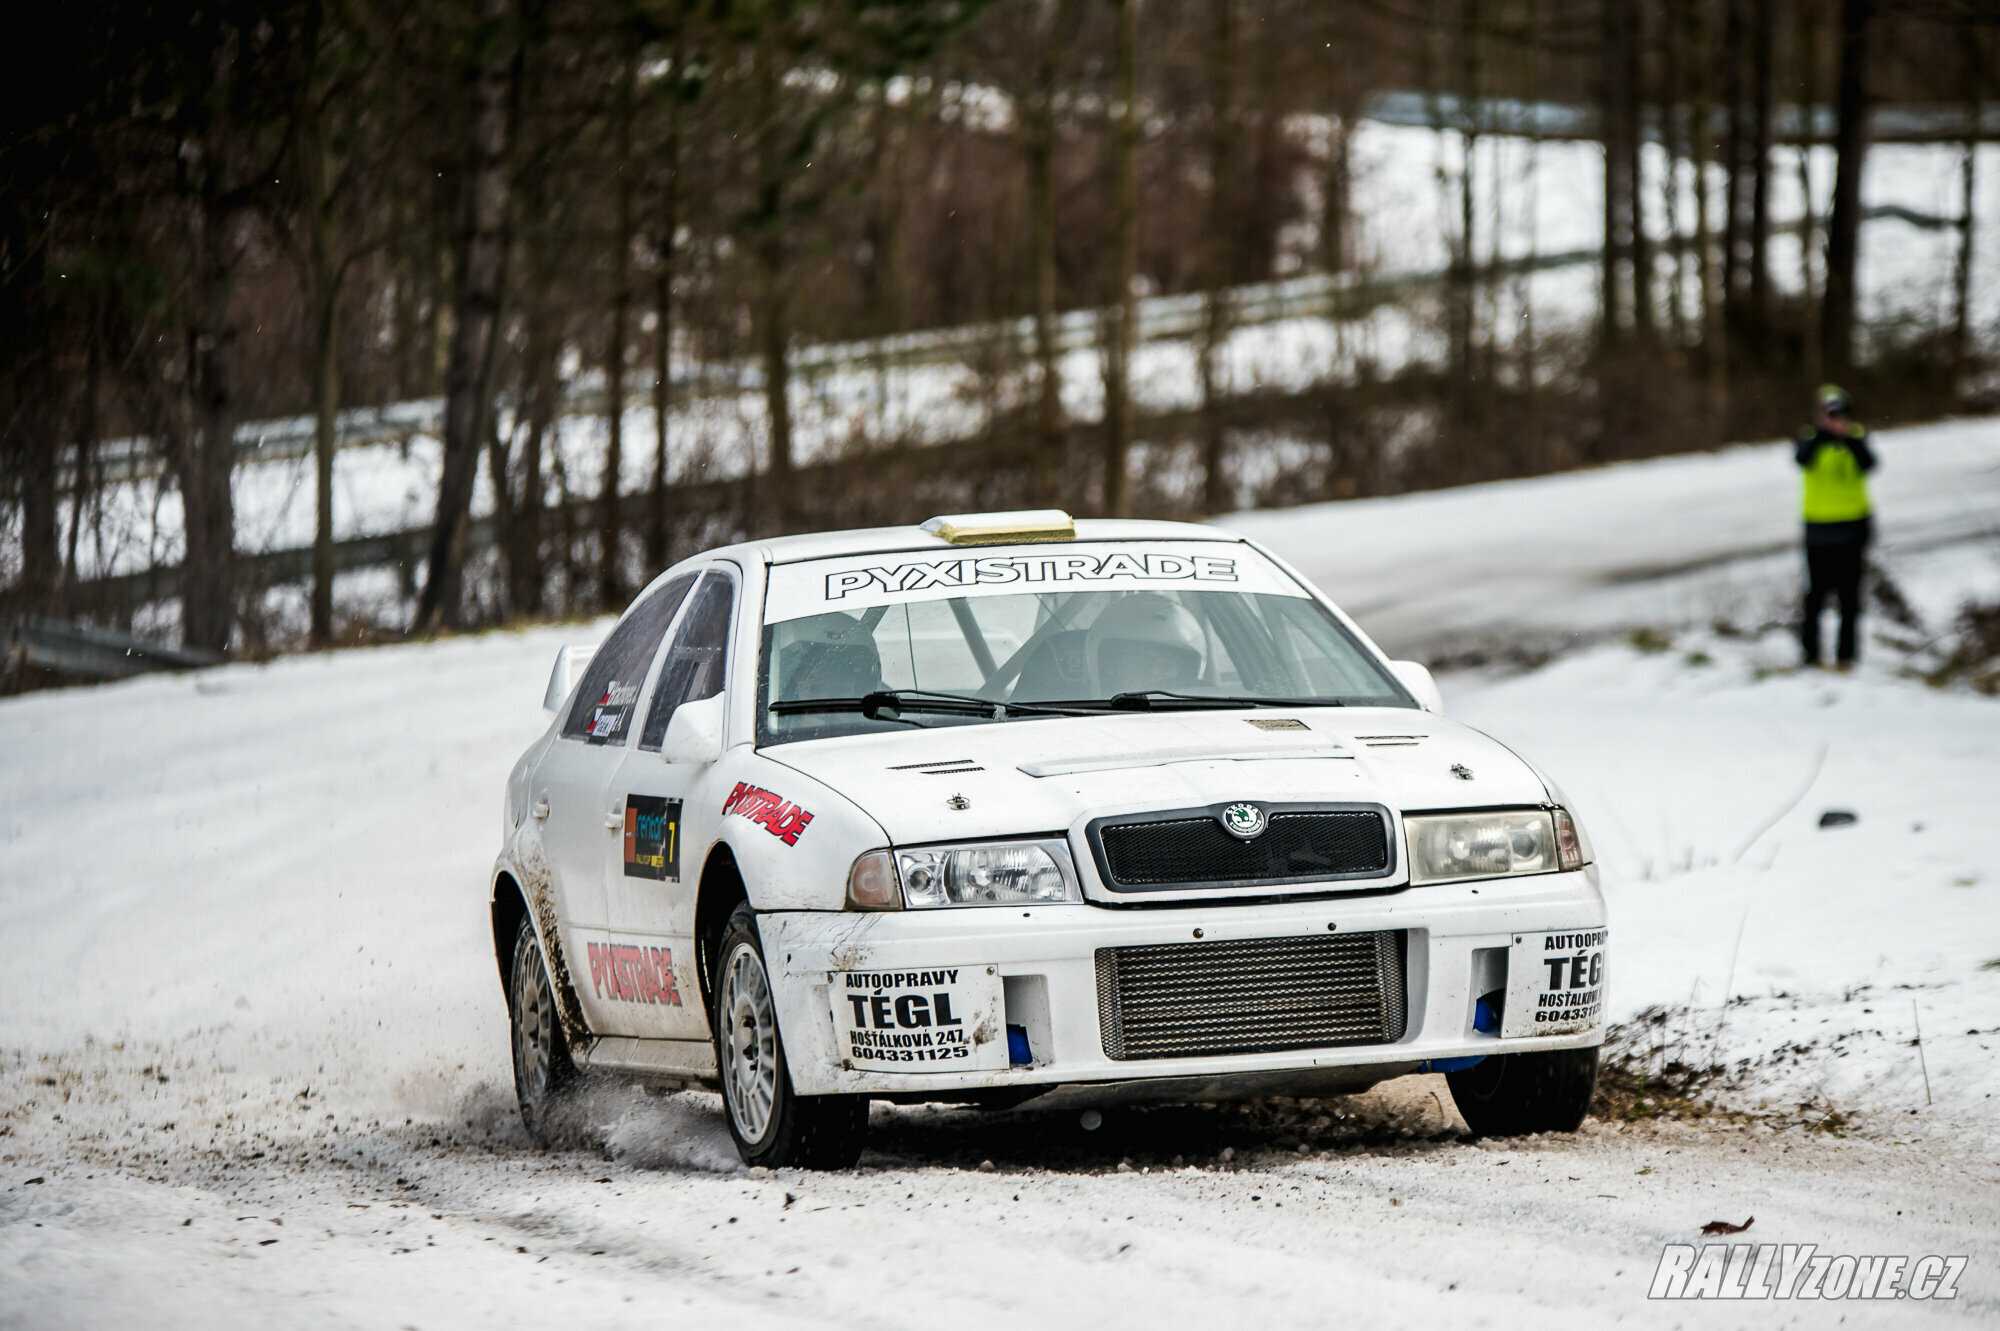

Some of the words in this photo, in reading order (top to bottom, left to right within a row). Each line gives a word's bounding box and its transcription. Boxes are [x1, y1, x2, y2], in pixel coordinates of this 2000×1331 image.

[825, 553, 1238, 600] PYXISTRADE
[846, 969, 959, 988] AUTOOPRAVY
[847, 988, 962, 1029] TÉGL
[936, 1029, 964, 1046] 247
[852, 1046, 969, 1062] 604331125
